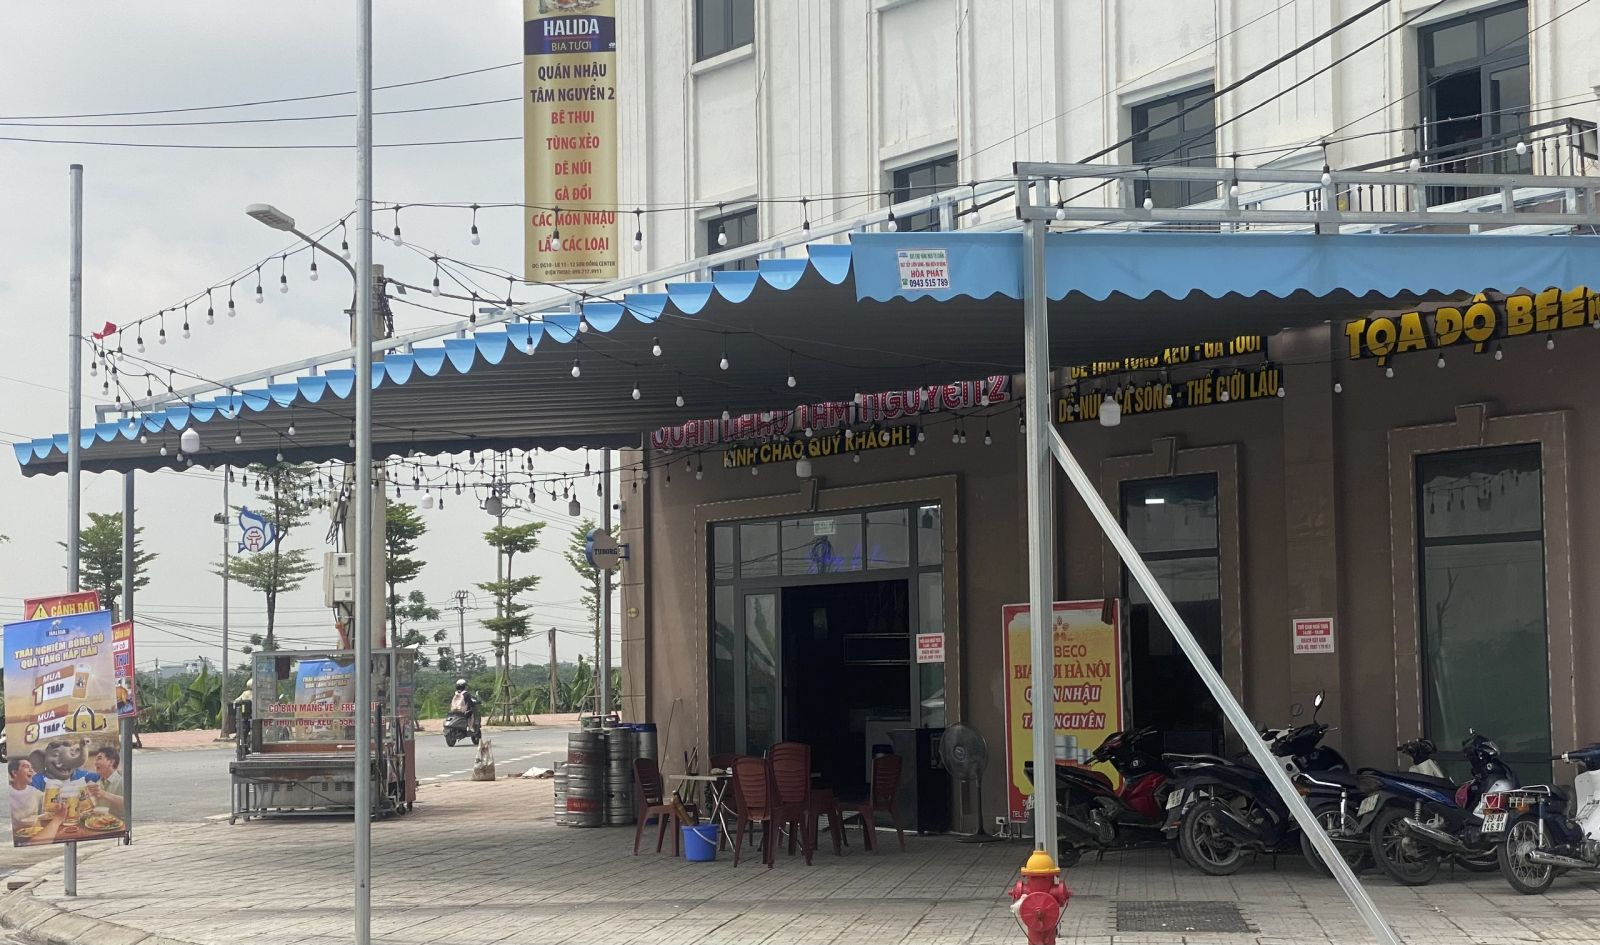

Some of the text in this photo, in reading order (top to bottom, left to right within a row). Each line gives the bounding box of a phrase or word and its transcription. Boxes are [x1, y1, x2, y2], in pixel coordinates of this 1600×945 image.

[543, 18, 600, 36] HALIDA
[551, 41, 592, 52] BIA TƯƠI
[538, 62, 607, 81] QUÁN NHẬU
[530, 84, 615, 103] TÂM NGUYÊN 2
[551, 109, 594, 124] BÊ THUI
[571, 159, 592, 174] NÚI
[555, 185, 569, 201] GÀ
[532, 210, 615, 228] CÁC MÓN NHẬU
[562, 235, 582, 251] CÁC
[585, 237, 609, 254] LOẠI
[910, 267, 943, 278] HÒA PHÁT
[909, 278, 949, 287] 0943 515 789
[1345, 311, 1427, 366] TỌA
[722, 444, 757, 468] KÍNH
[759, 437, 804, 463] CHÀO
[808, 431, 841, 457] QUÝ
[50, 599, 95, 617] CẢNH BÁO
[42, 671, 61, 682] MUA
[1065, 660, 1084, 679] HÀ
[1086, 659, 1112, 682] NỘI
[32, 683, 65, 705] 1 THÁP
[1064, 682, 1101, 705] NHẬU
[37, 710, 56, 723] MUA
[300, 703, 322, 712] MANG
[1054, 711, 1105, 728] NGUYÊN
[25, 721, 60, 744] 3 THÁP
